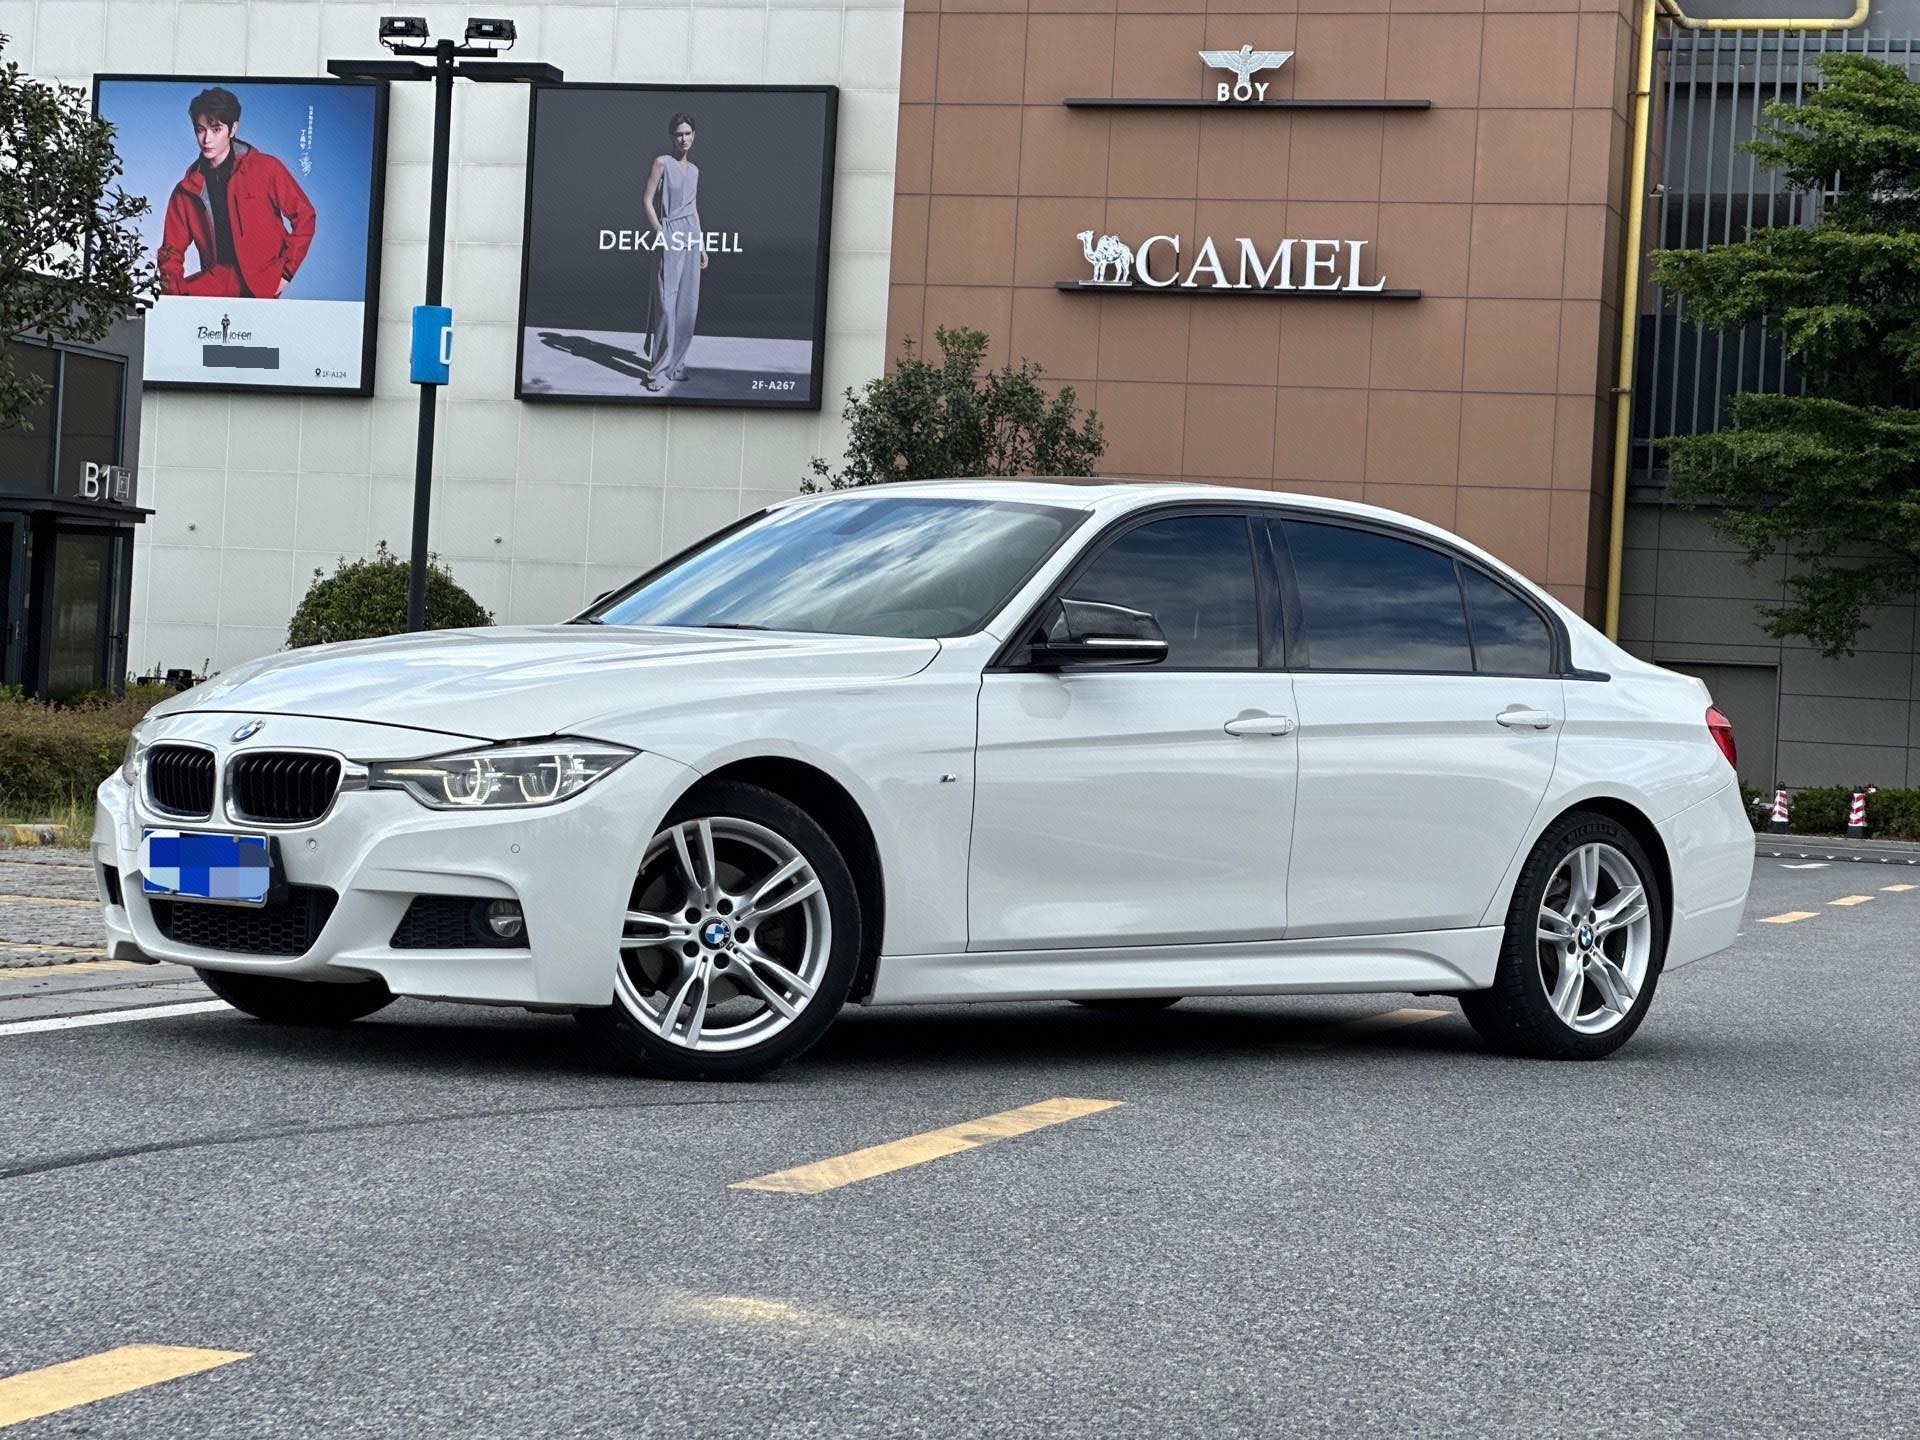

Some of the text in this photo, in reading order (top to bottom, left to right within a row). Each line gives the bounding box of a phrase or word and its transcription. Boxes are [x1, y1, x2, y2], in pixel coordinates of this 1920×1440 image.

[1217, 82, 1269, 102] BOY
[599, 230, 743, 252] DEKASHELL
[1136, 234, 1386, 292] CAMEL
[751, 380, 796, 390] 2F-A267
[84, 461, 110, 500] B1
